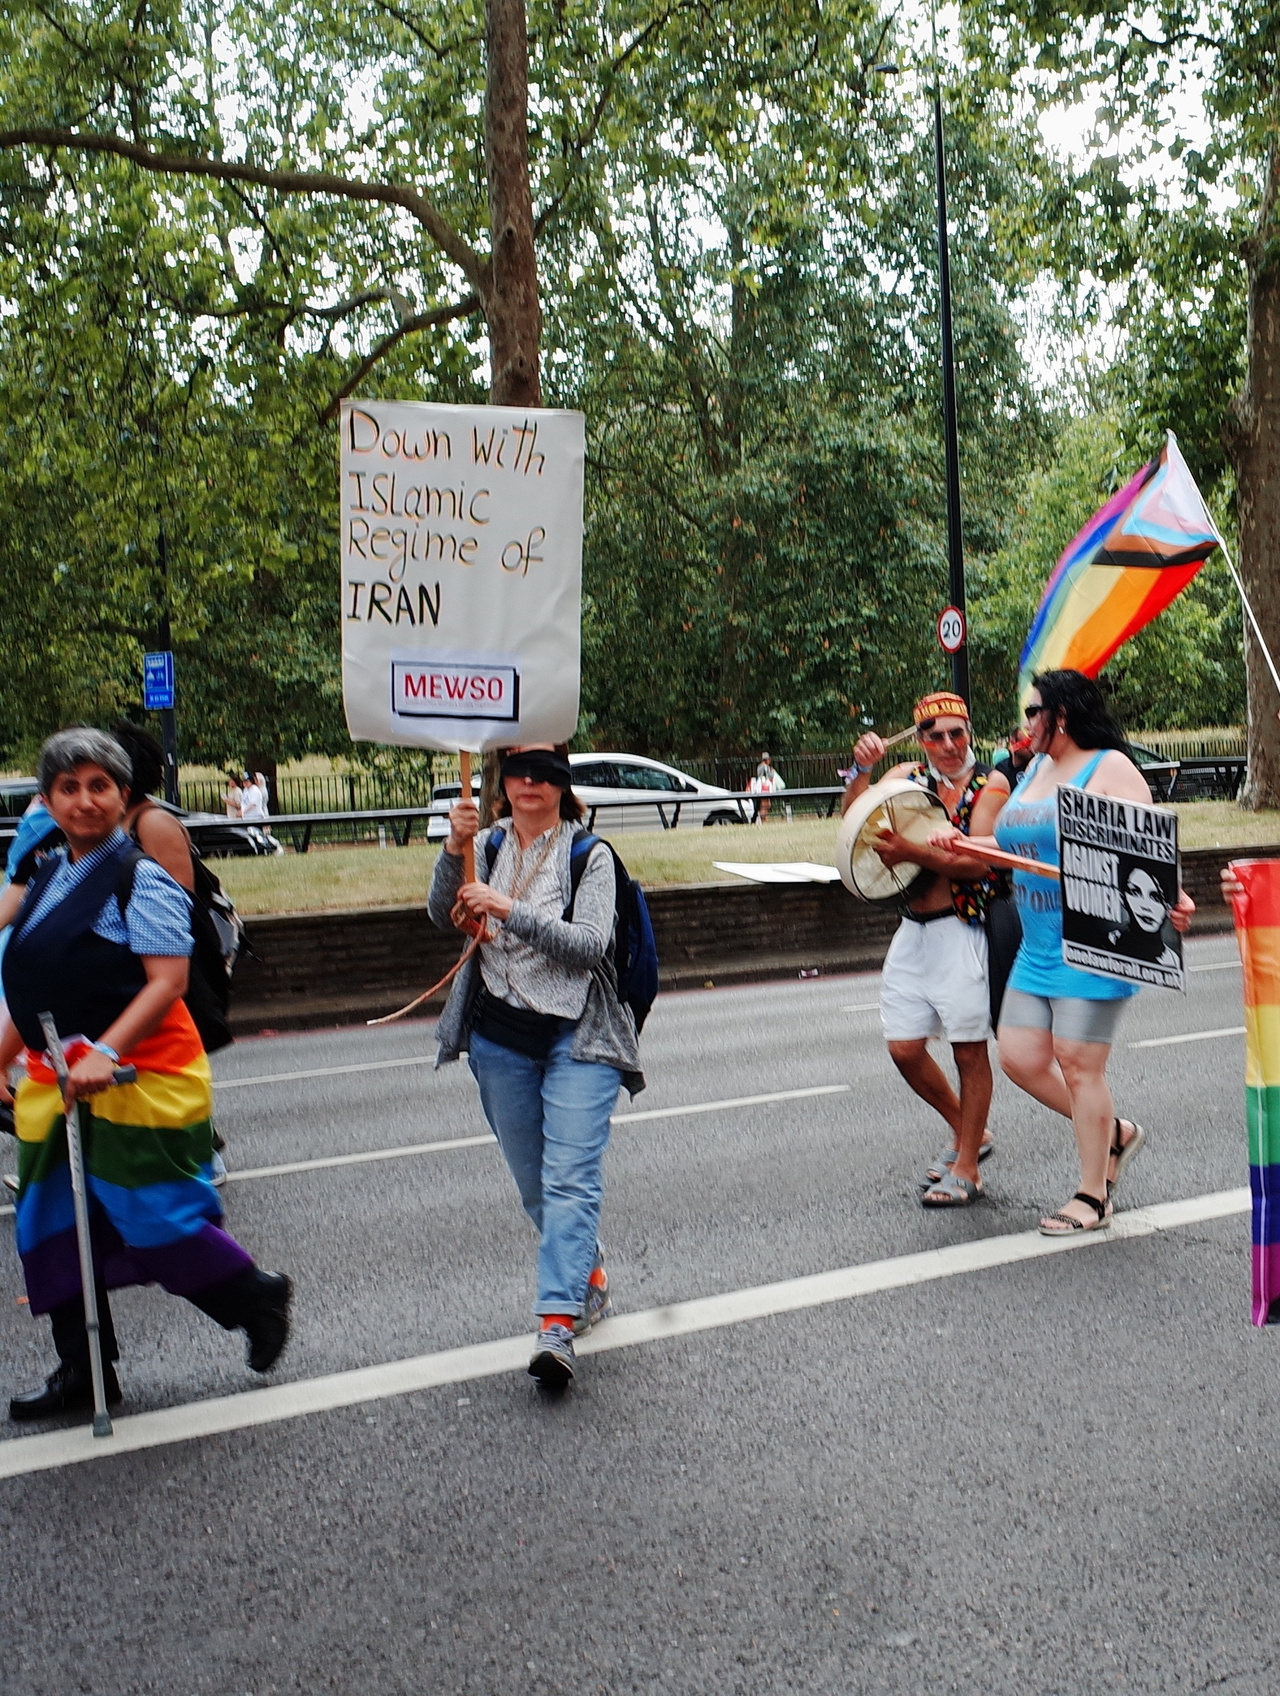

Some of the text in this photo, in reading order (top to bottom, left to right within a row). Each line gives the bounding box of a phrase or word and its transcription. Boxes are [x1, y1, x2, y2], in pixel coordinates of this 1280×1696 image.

[350, 408, 451, 460] Down
[349, 518, 546, 583] Regime of
[347, 579, 442, 628] IRAN
[942, 619, 961, 639] 20
[404, 672, 504, 702] MEWSO
[1060, 815, 1176, 863] DISCRIMINATES
[1061, 790, 1127, 832] SHARIA
[1134, 807, 1173, 842] LAW
[1063, 840, 1120, 889] AGAINST
[1063, 875, 1125, 924] WOMEN
